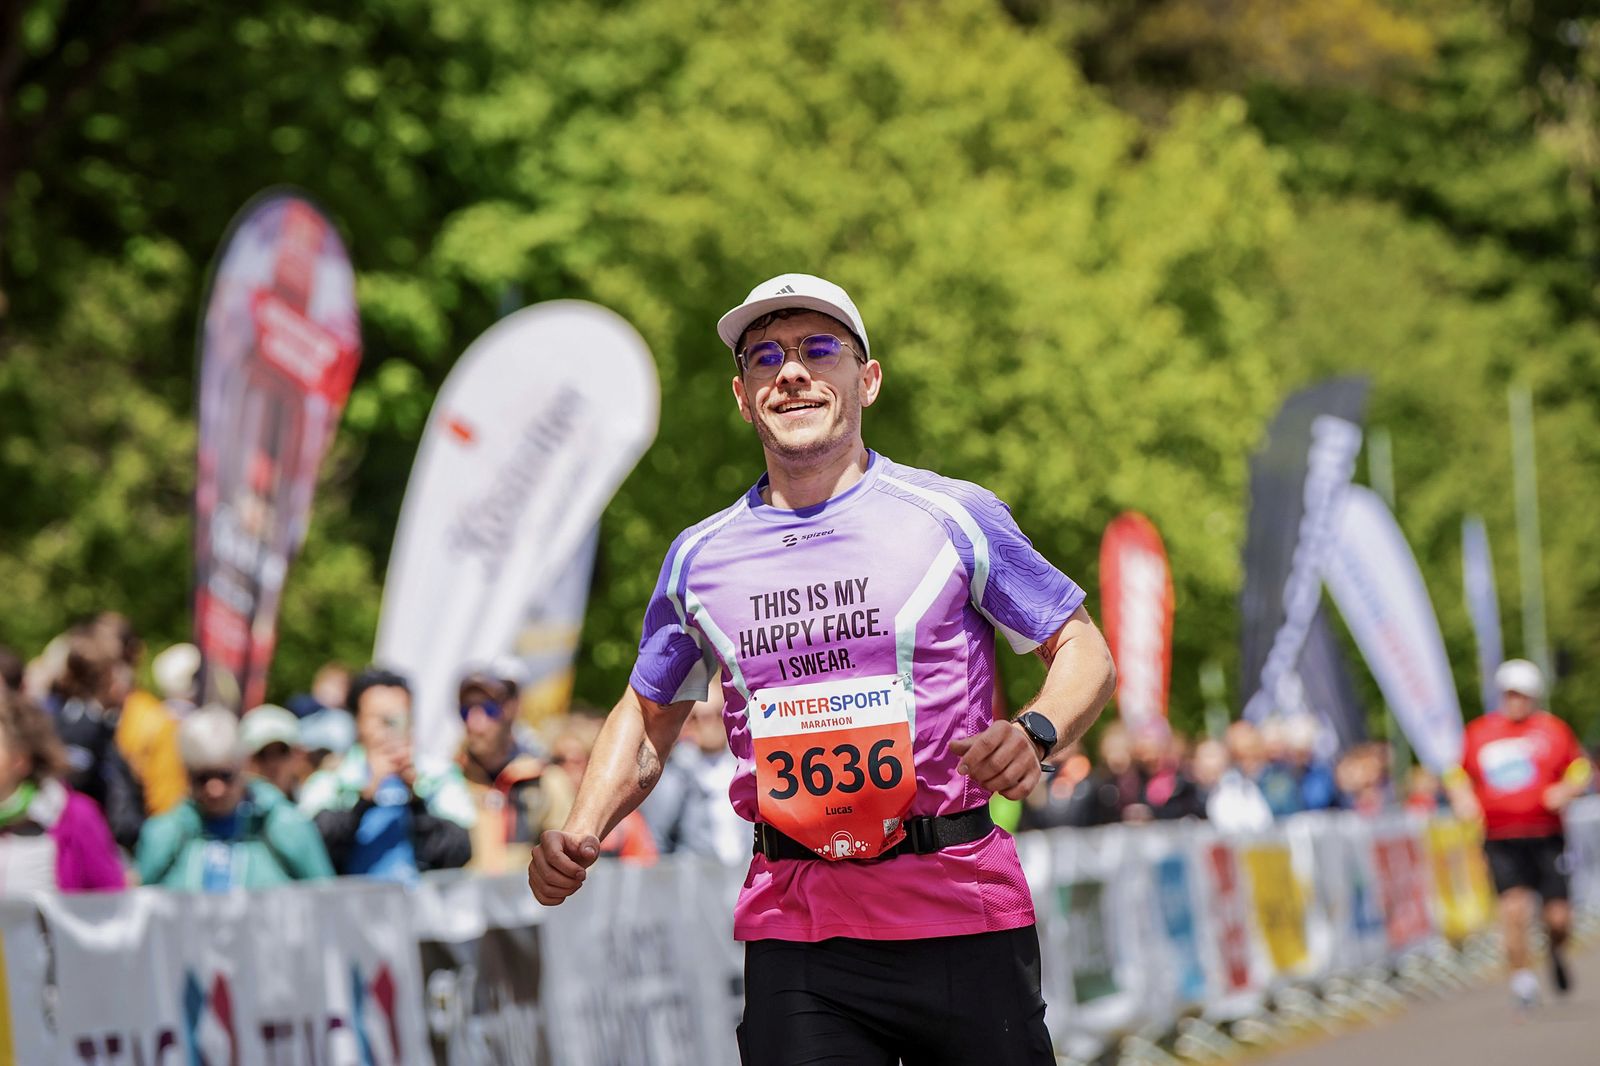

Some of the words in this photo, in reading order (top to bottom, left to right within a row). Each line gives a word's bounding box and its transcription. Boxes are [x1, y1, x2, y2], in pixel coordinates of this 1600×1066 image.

[801, 528, 835, 540] spized
[750, 588, 800, 621] THIS
[807, 583, 829, 612] IS
[834, 577, 869, 607] MY
[739, 618, 816, 659] HAPPY
[823, 608, 889, 643] FACE.
[778, 659, 788, 681] I
[791, 648, 856, 679] SWEAR.
[778, 689, 892, 718] INTERSPORT
[800, 716, 853, 730] MARATHON
[766, 739, 903, 800] 3636
[825, 805, 853, 816] Lucas
